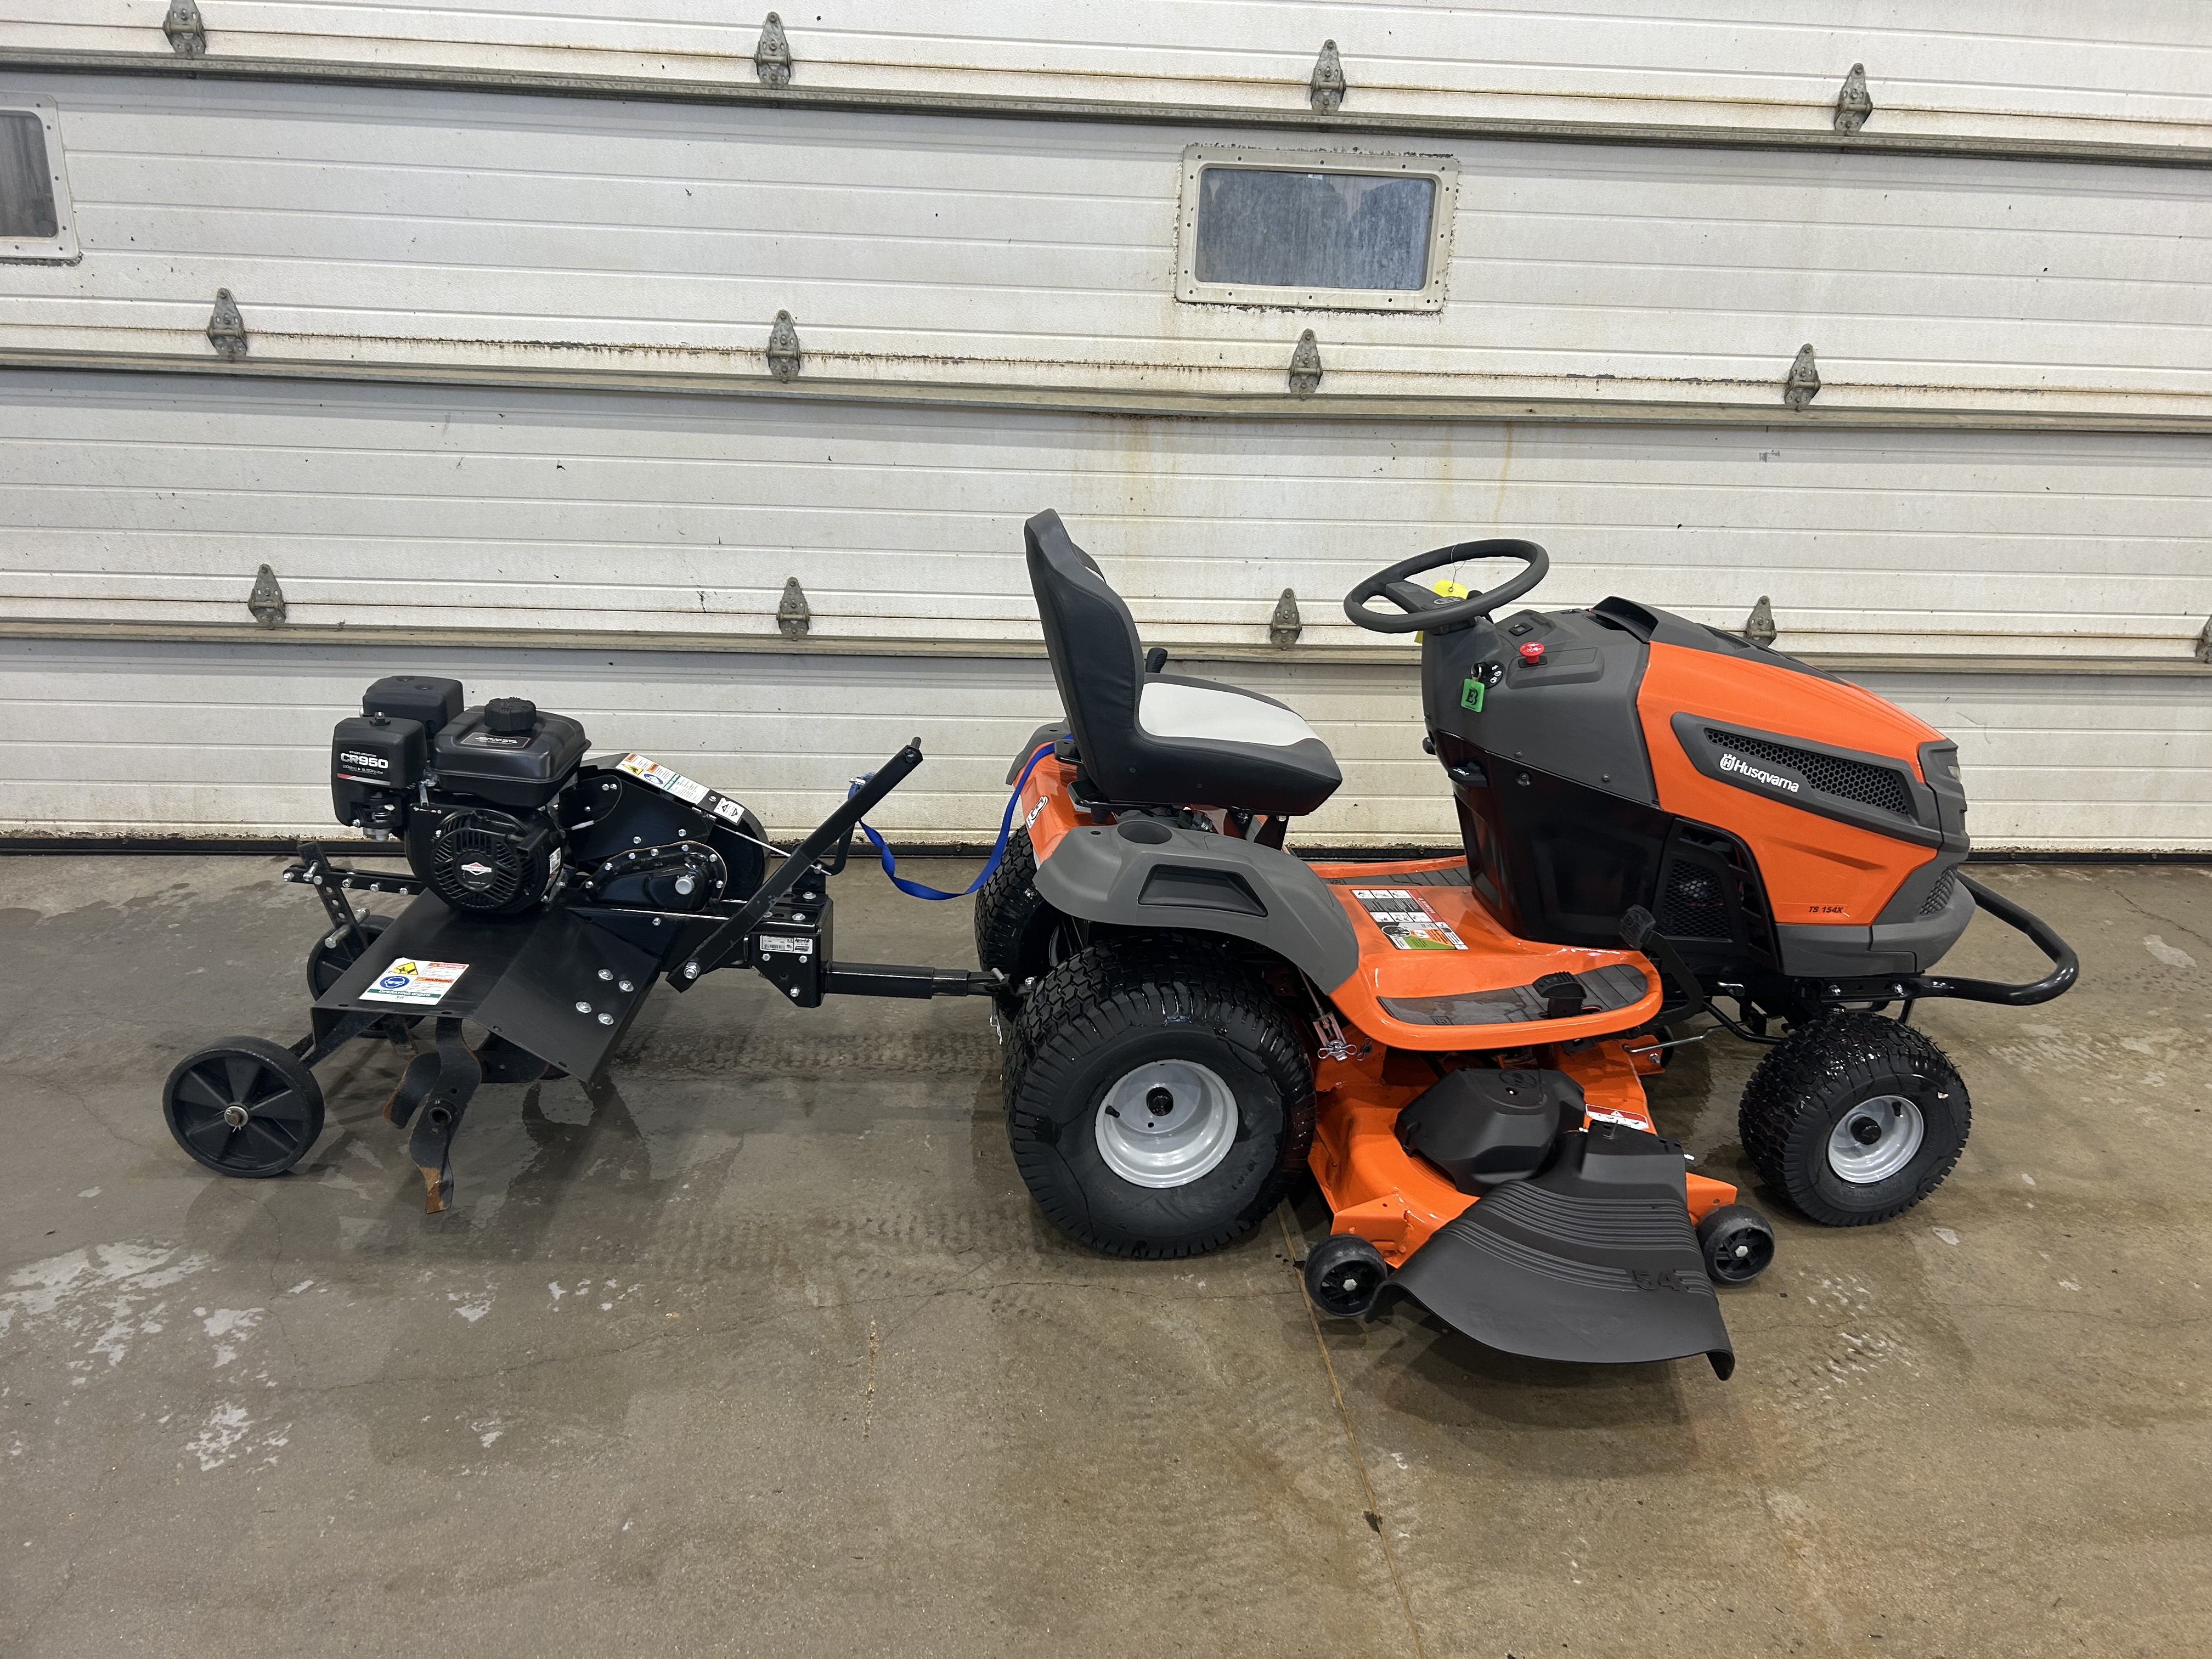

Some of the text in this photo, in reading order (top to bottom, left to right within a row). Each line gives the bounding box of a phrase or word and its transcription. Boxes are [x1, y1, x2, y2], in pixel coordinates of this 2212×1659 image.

[340, 753, 388, 769] CR950
[1733, 759, 1800, 793] Husqvarna
[1632, 1269, 1680, 1291] 54
